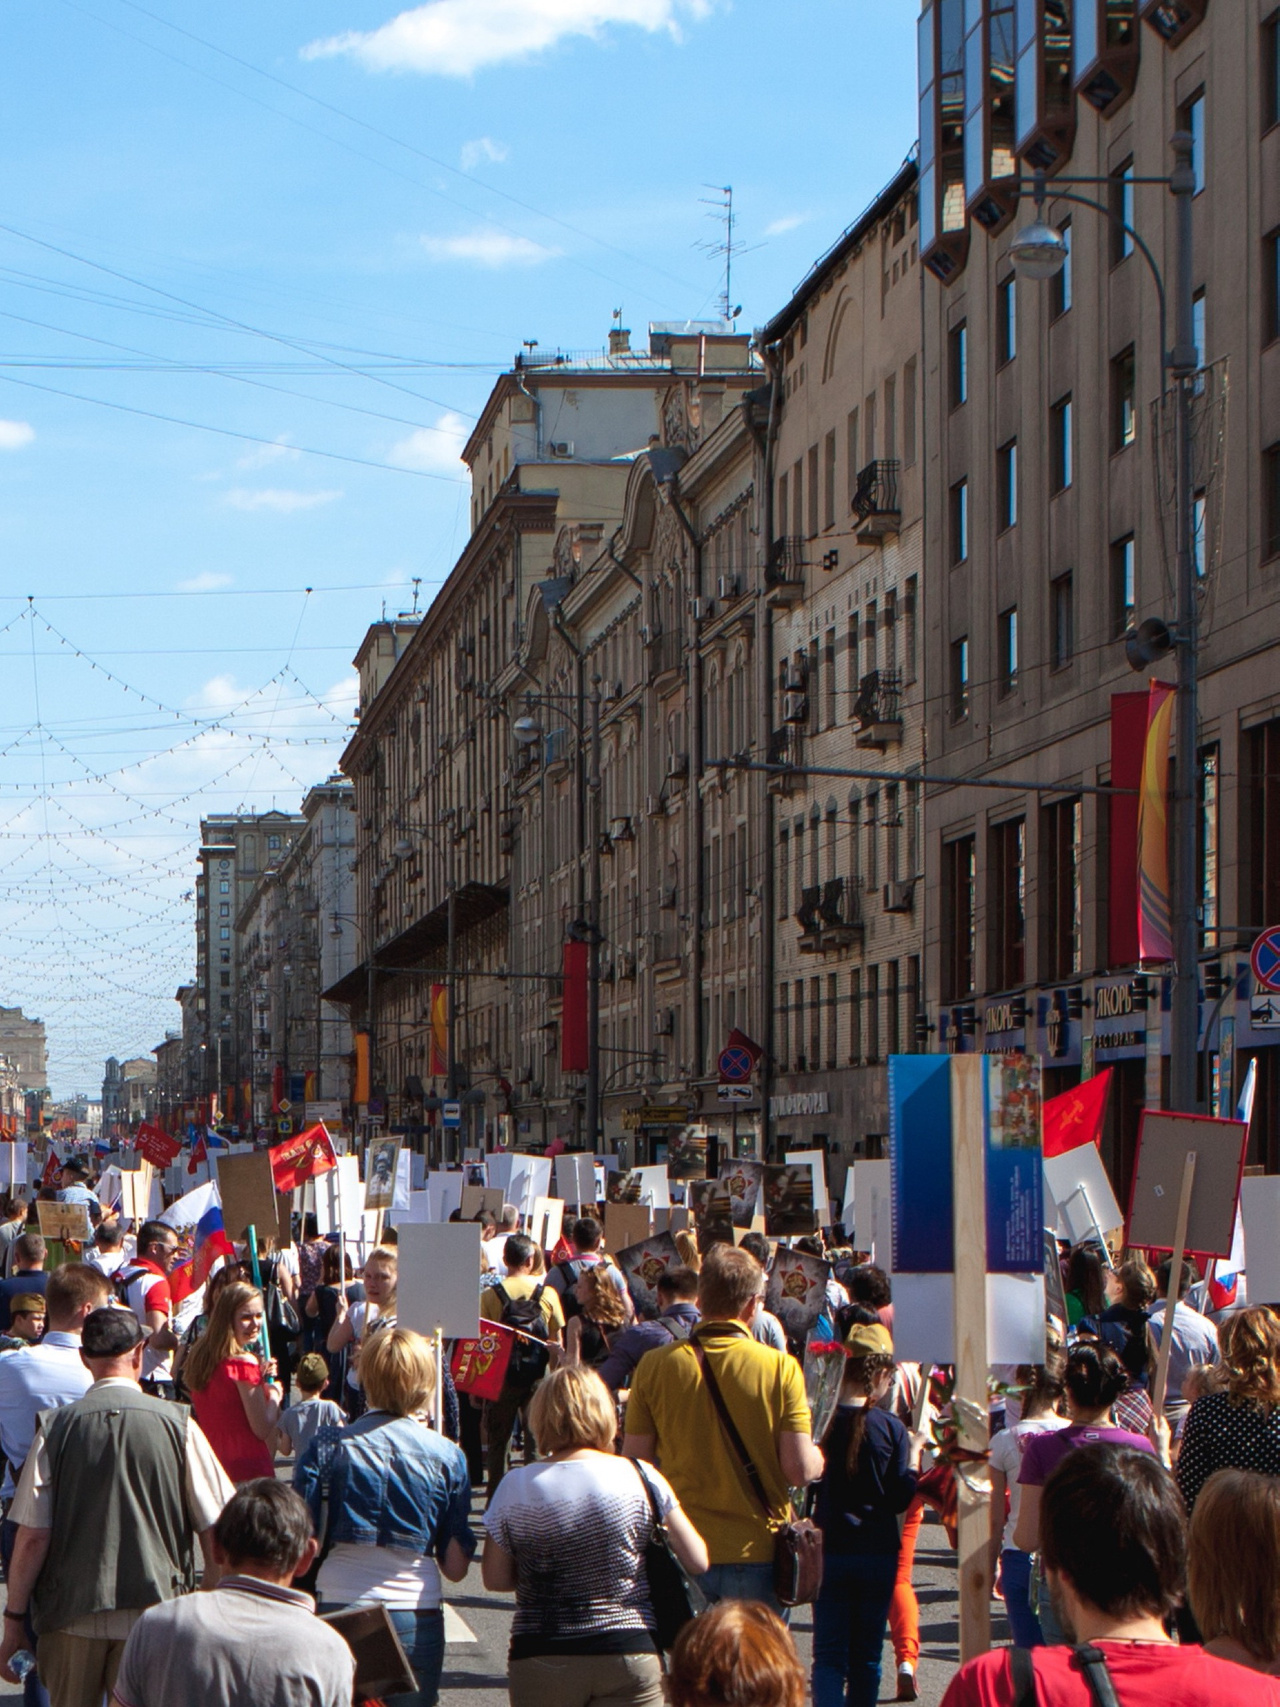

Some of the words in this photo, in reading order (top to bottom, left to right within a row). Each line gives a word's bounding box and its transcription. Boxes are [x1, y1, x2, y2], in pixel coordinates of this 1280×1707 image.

[1096, 984, 1132, 1018] ЯКОРЬ
[986, 1003, 1013, 1033] ЯКОРЬ
[1092, 1031, 1136, 1049] РЕСТОРАН
